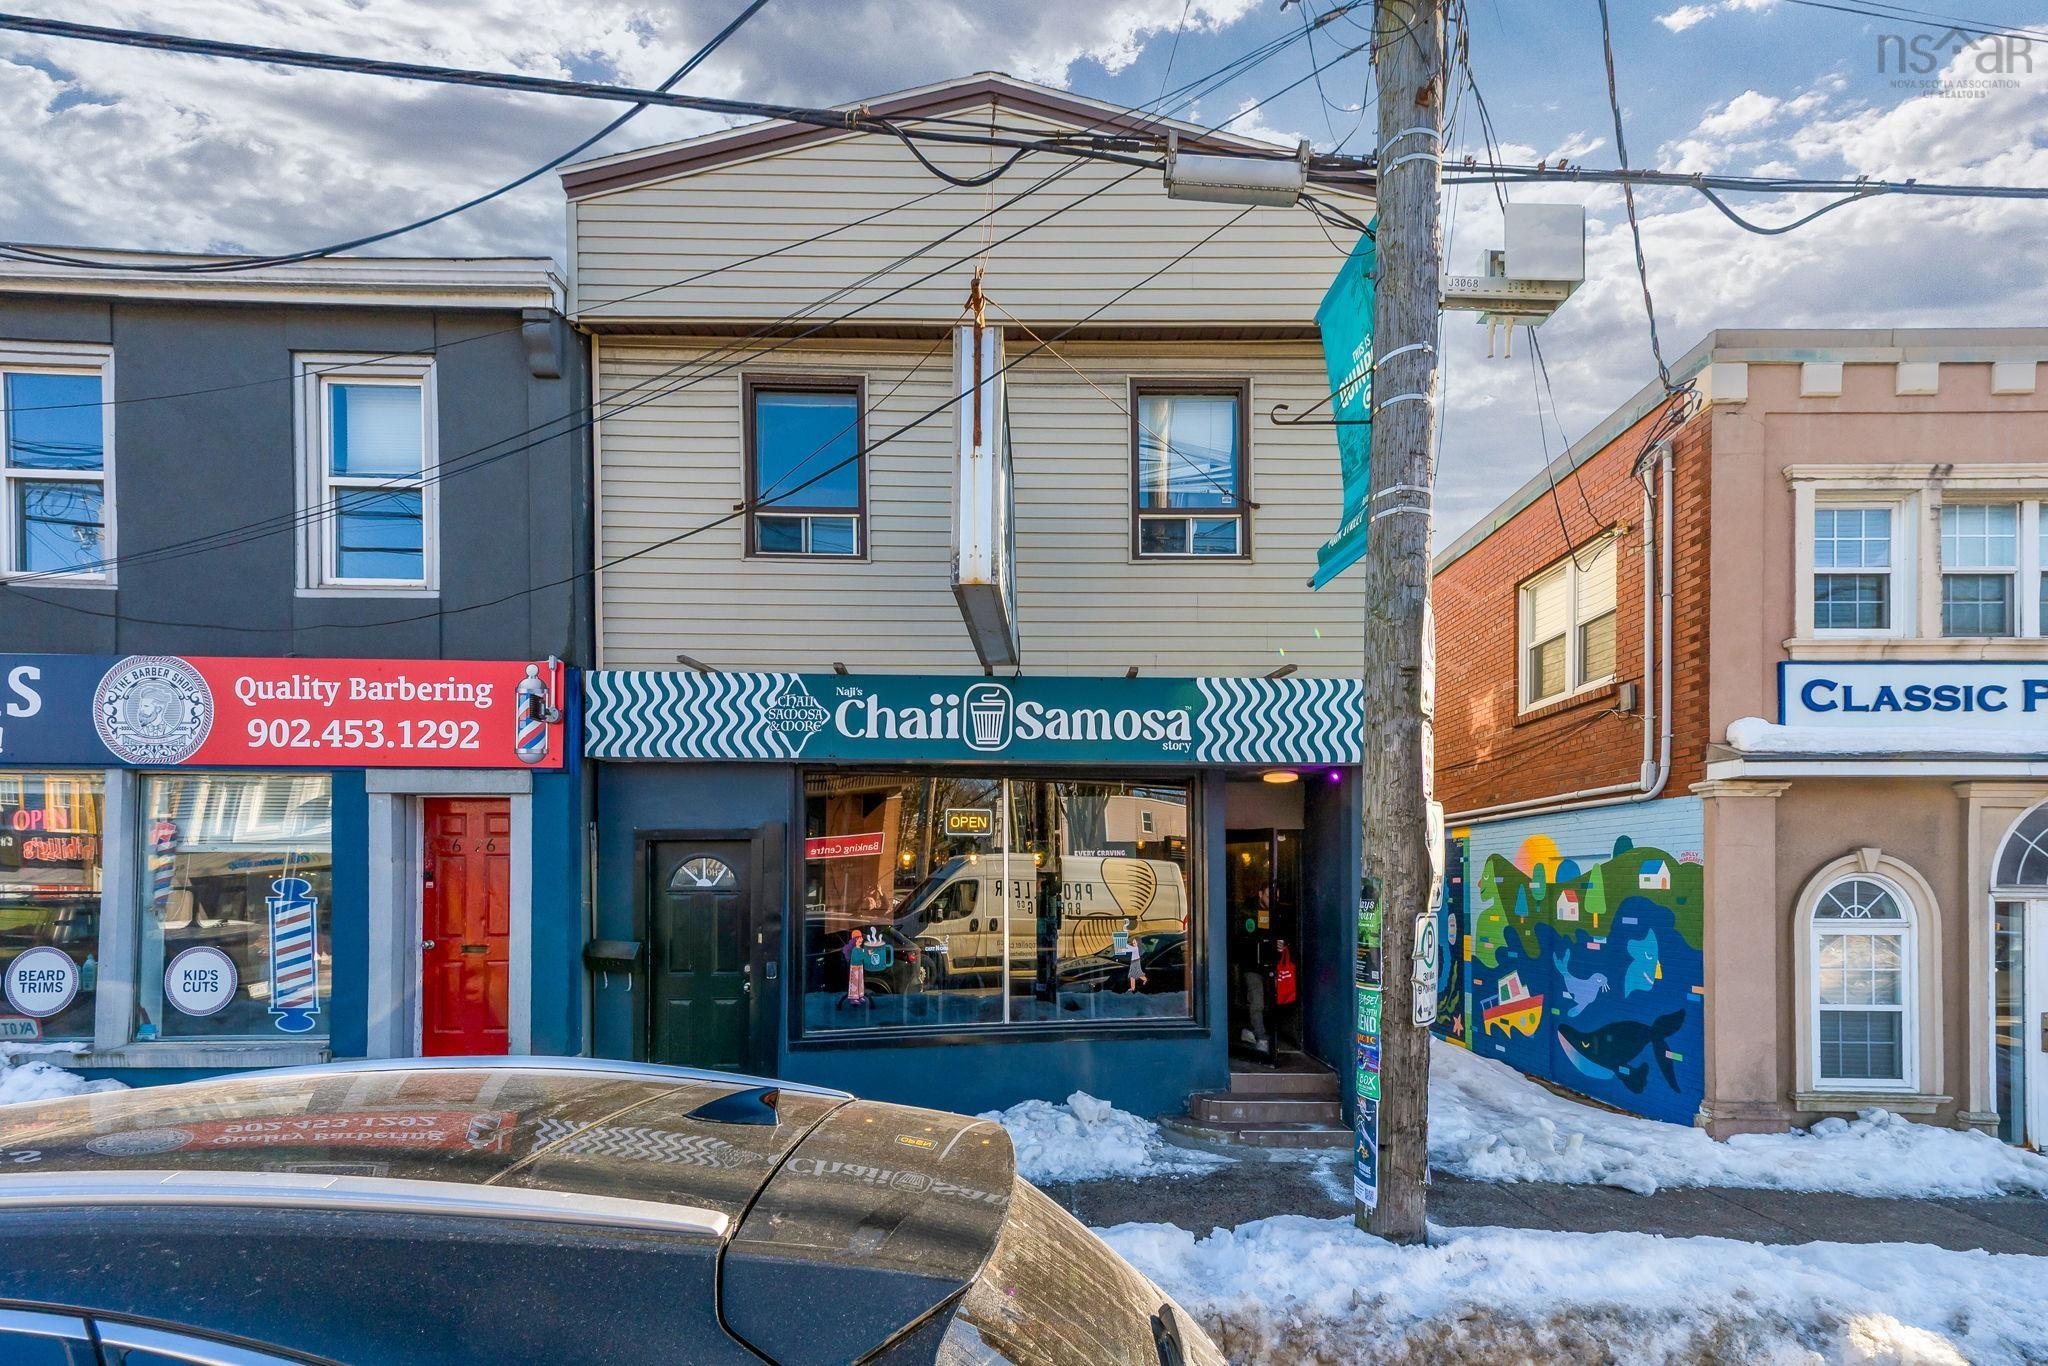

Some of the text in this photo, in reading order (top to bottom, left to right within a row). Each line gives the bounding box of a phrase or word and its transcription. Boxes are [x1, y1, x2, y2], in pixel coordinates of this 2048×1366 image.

[1448, 278, 1479, 288] J3068
[1339, 344, 1374, 409] QUINP
[114, 667, 194, 693] THE BARBER SHOP
[234, 674, 494, 708] Quality Barbering
[836, 687, 863, 698] Naji's
[1801, 678, 2009, 712] CLASSIC
[768, 708, 823, 720] SAMOSA
[835, 693, 960, 739] Chaii
[1015, 701, 1192, 741] Samosa
[247, 718, 480, 749] 902.453.1292
[1162, 740, 1192, 753] story
[13, 809, 68, 831] OPEN
[950, 816, 987, 828] OPEN
[18, 969, 66, 981] BEARD
[183, 969, 219, 981] KID'S
[19, 981, 63, 994] TRIMS
[182, 981, 219, 993] CUTS
[1, 1021, 36, 1035] TO YA
